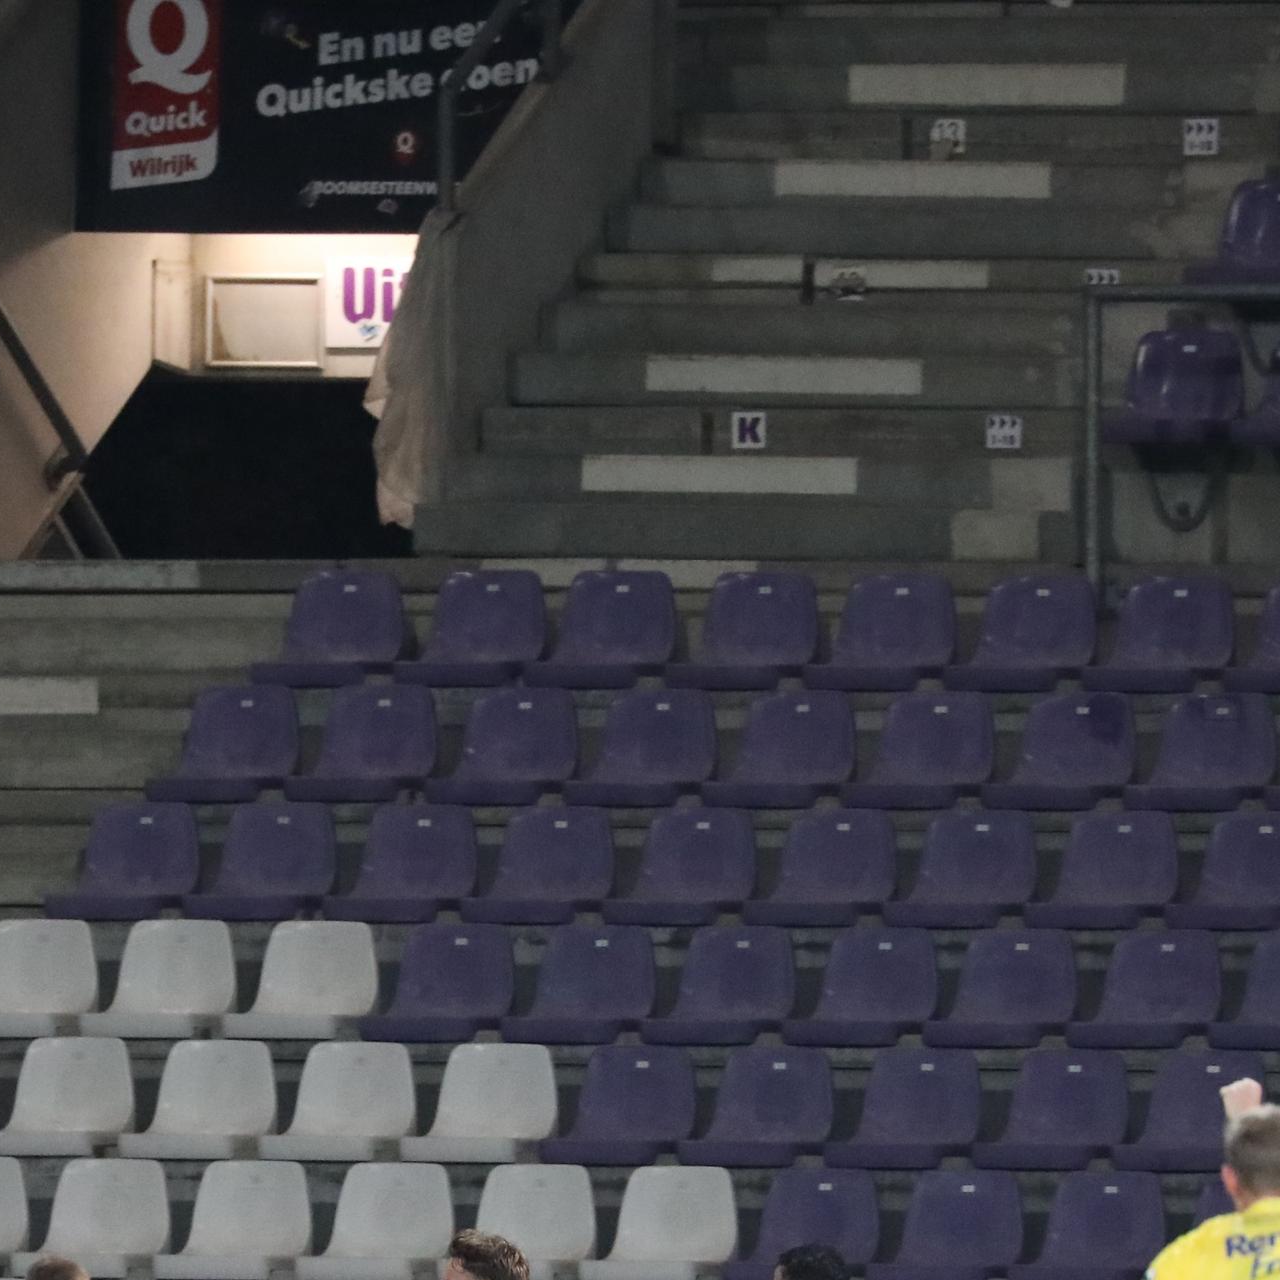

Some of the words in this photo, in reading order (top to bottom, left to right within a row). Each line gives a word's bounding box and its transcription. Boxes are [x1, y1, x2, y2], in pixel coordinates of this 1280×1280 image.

[126, 0, 213, 94] Q
[319, 32, 365, 65] En
[373, 29, 422, 58] nu
[256, 68, 434, 117] Quickske
[125, 101, 208, 137] Quick
[129, 153, 198, 177] Wilrijk
[738, 416, 762, 443] K
